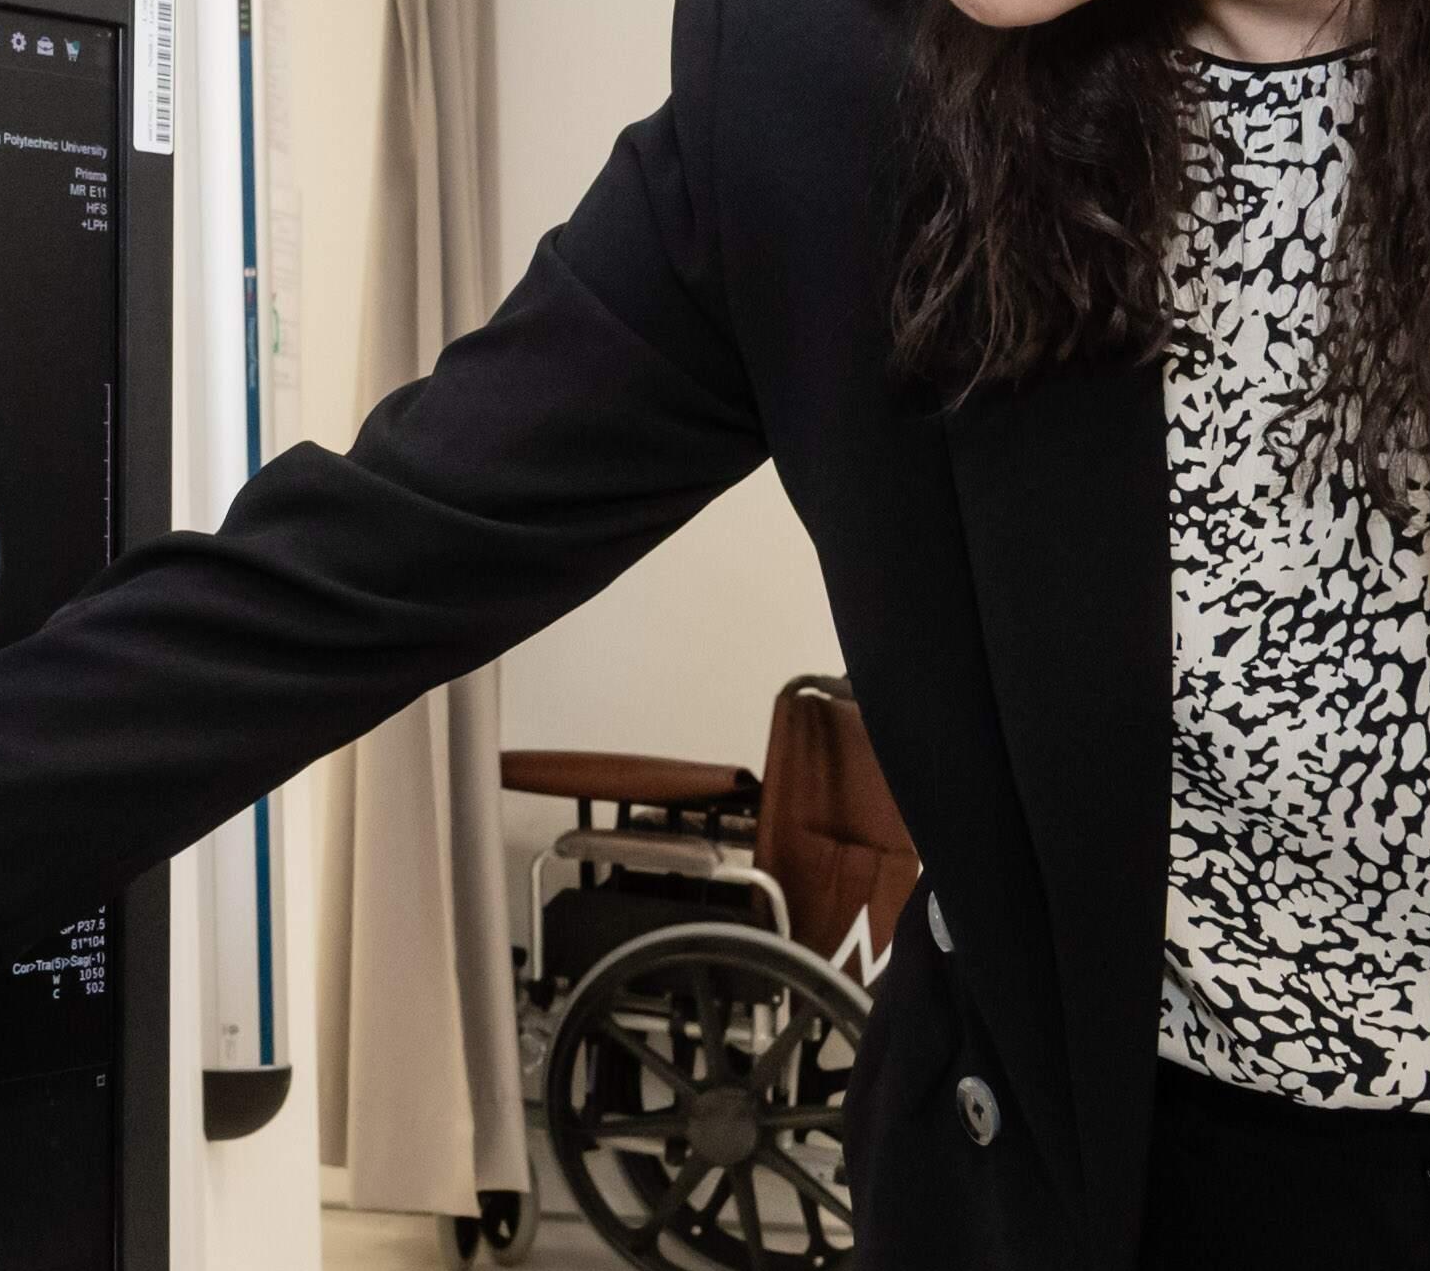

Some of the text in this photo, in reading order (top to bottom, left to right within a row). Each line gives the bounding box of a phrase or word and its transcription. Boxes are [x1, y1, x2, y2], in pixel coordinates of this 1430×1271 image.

[3, 132, 59, 152] Polytechnic
[61, 138, 107, 158] University
[75, 167, 107, 183] Prisma
[70, 183, 107, 199] MR E11
[86, 203, 107, 216] HFS
[78, 919, 105, 932] P37.5
[53, 967, 104, 985] W 1050
[53, 981, 104, 999] C 502
